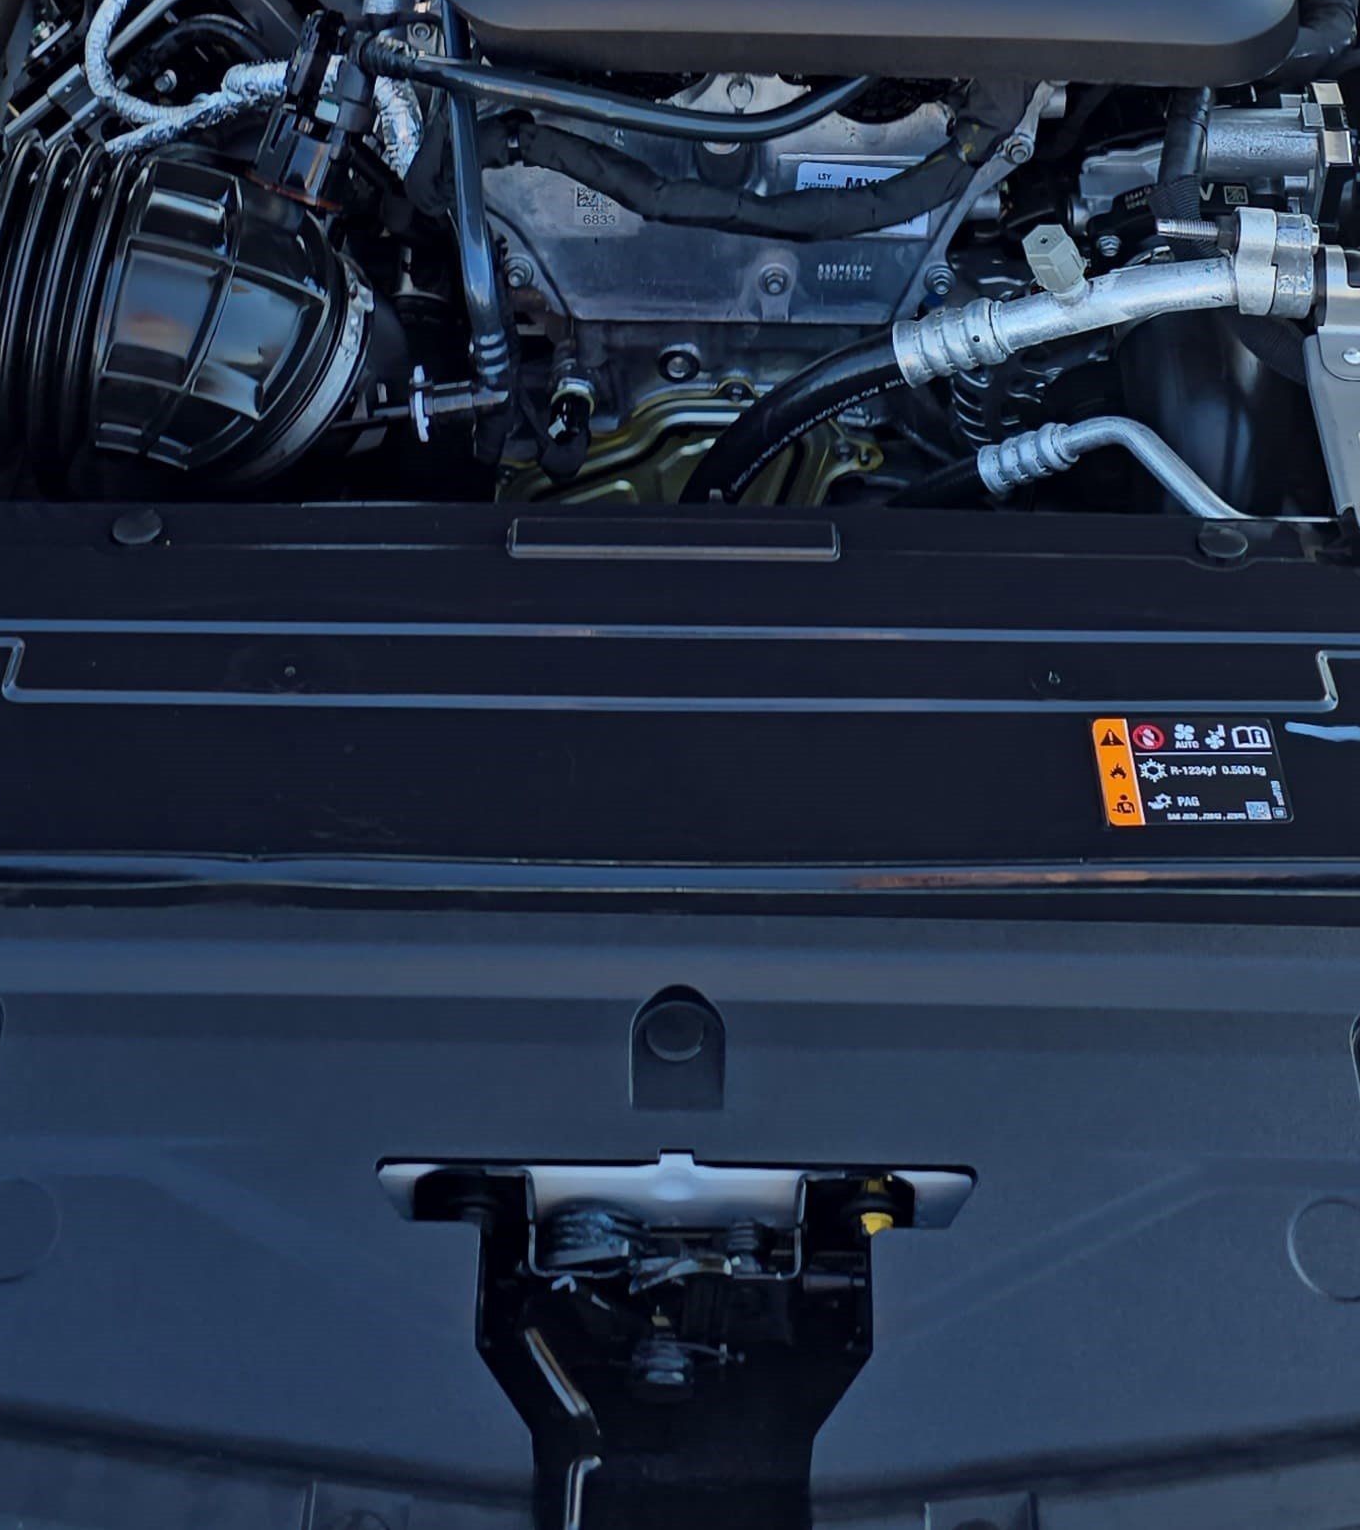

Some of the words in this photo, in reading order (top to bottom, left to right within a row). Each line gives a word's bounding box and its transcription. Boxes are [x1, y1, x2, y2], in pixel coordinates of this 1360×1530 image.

[583, 215, 616, 225] 6833
[1175, 740, 1200, 749] AUTO
[1170, 766, 1217, 777] R-1234yf
[1252, 766, 1267, 777] kg
[1176, 796, 1200, 807] PAG
